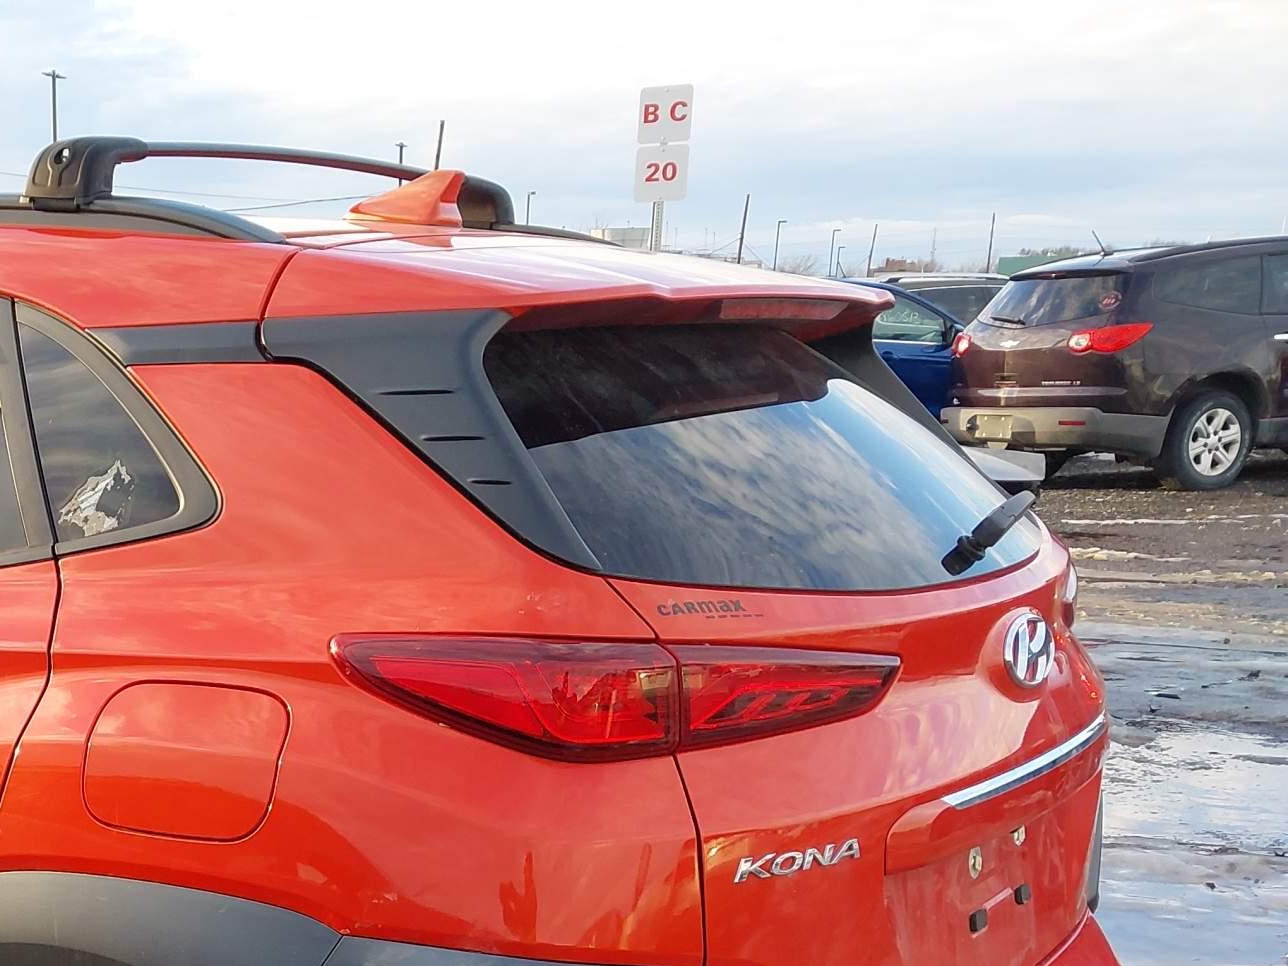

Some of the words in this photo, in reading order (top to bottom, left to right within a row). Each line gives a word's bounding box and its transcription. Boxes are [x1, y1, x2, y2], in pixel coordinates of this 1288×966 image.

[643, 103, 660, 124] B
[670, 101, 688, 121] C
[645, 162, 677, 182] 20
[733, 837, 862, 884] KONA
